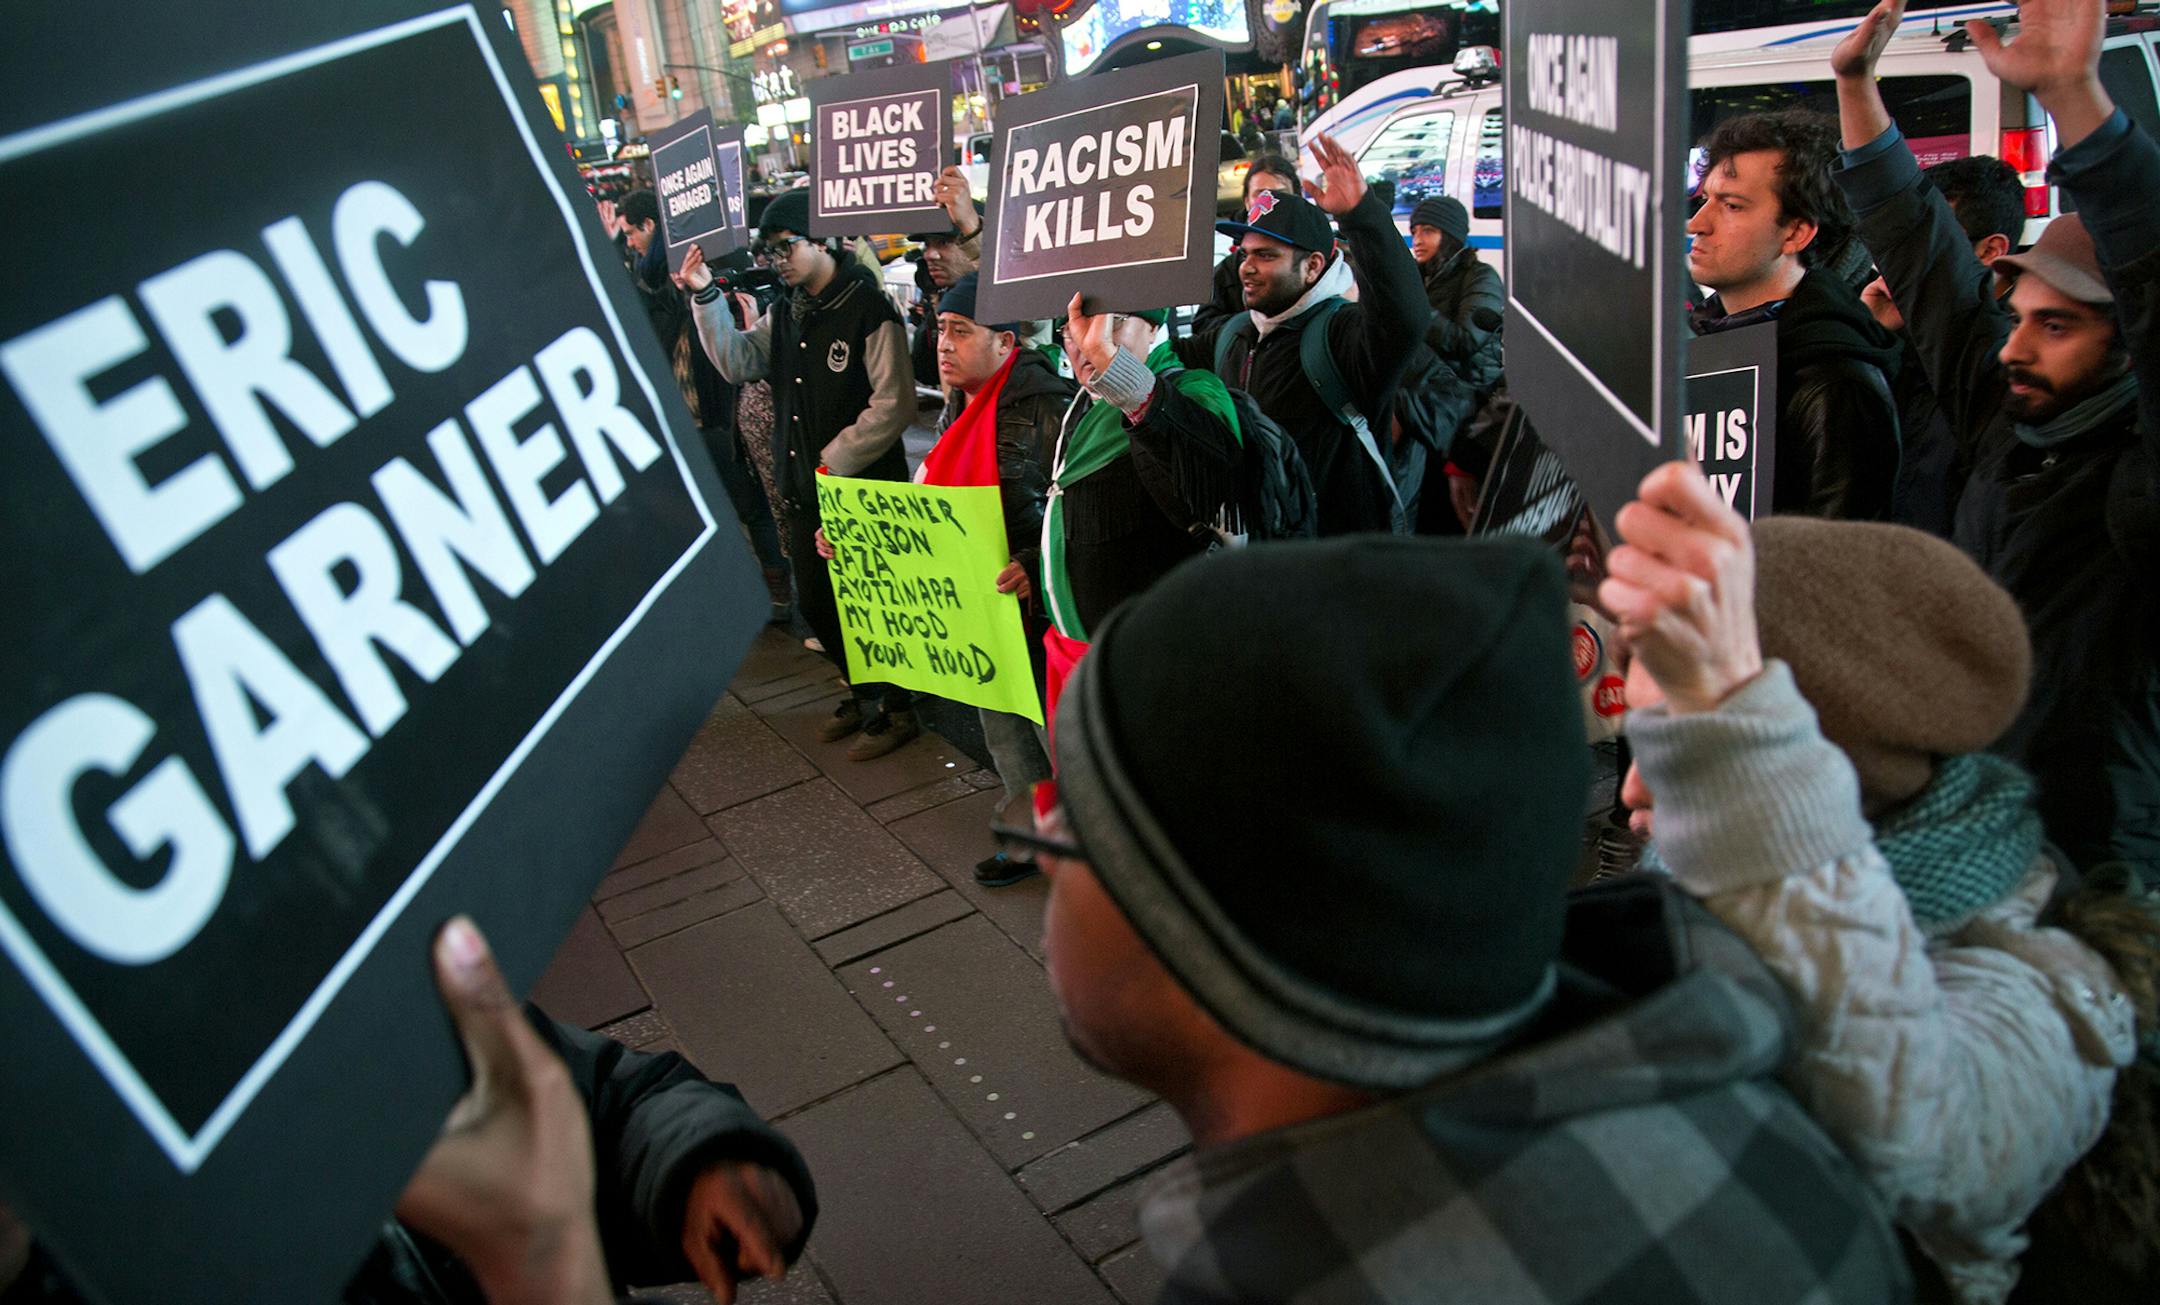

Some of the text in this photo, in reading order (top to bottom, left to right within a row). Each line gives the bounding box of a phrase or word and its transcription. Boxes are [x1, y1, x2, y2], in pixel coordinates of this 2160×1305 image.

[1527, 32, 1618, 133] ONCE AGAIN
[832, 101, 924, 140] BLACK
[661, 157, 713, 196] ONCE AGAIN
[838, 137, 917, 174] LIVES
[1010, 115, 1186, 198] RACISM
[669, 184, 712, 217] ENRAGED
[823, 171, 935, 209] MATTER
[1512, 123, 1651, 270] POLICE BRUTALITY
[1023, 184, 1155, 253] KILLS
[0, 180, 468, 575] ERIC
[1715, 408, 1747, 461] IS
[817, 482, 967, 536] RIC GARNER
[825, 517, 934, 557] ERGUSON
[838, 576, 962, 610] AYOTZINAPA
[0, 324, 662, 965] GARNER
[844, 604, 948, 640] MY HOOD
[854, 636, 996, 685] YOUR HOOD
